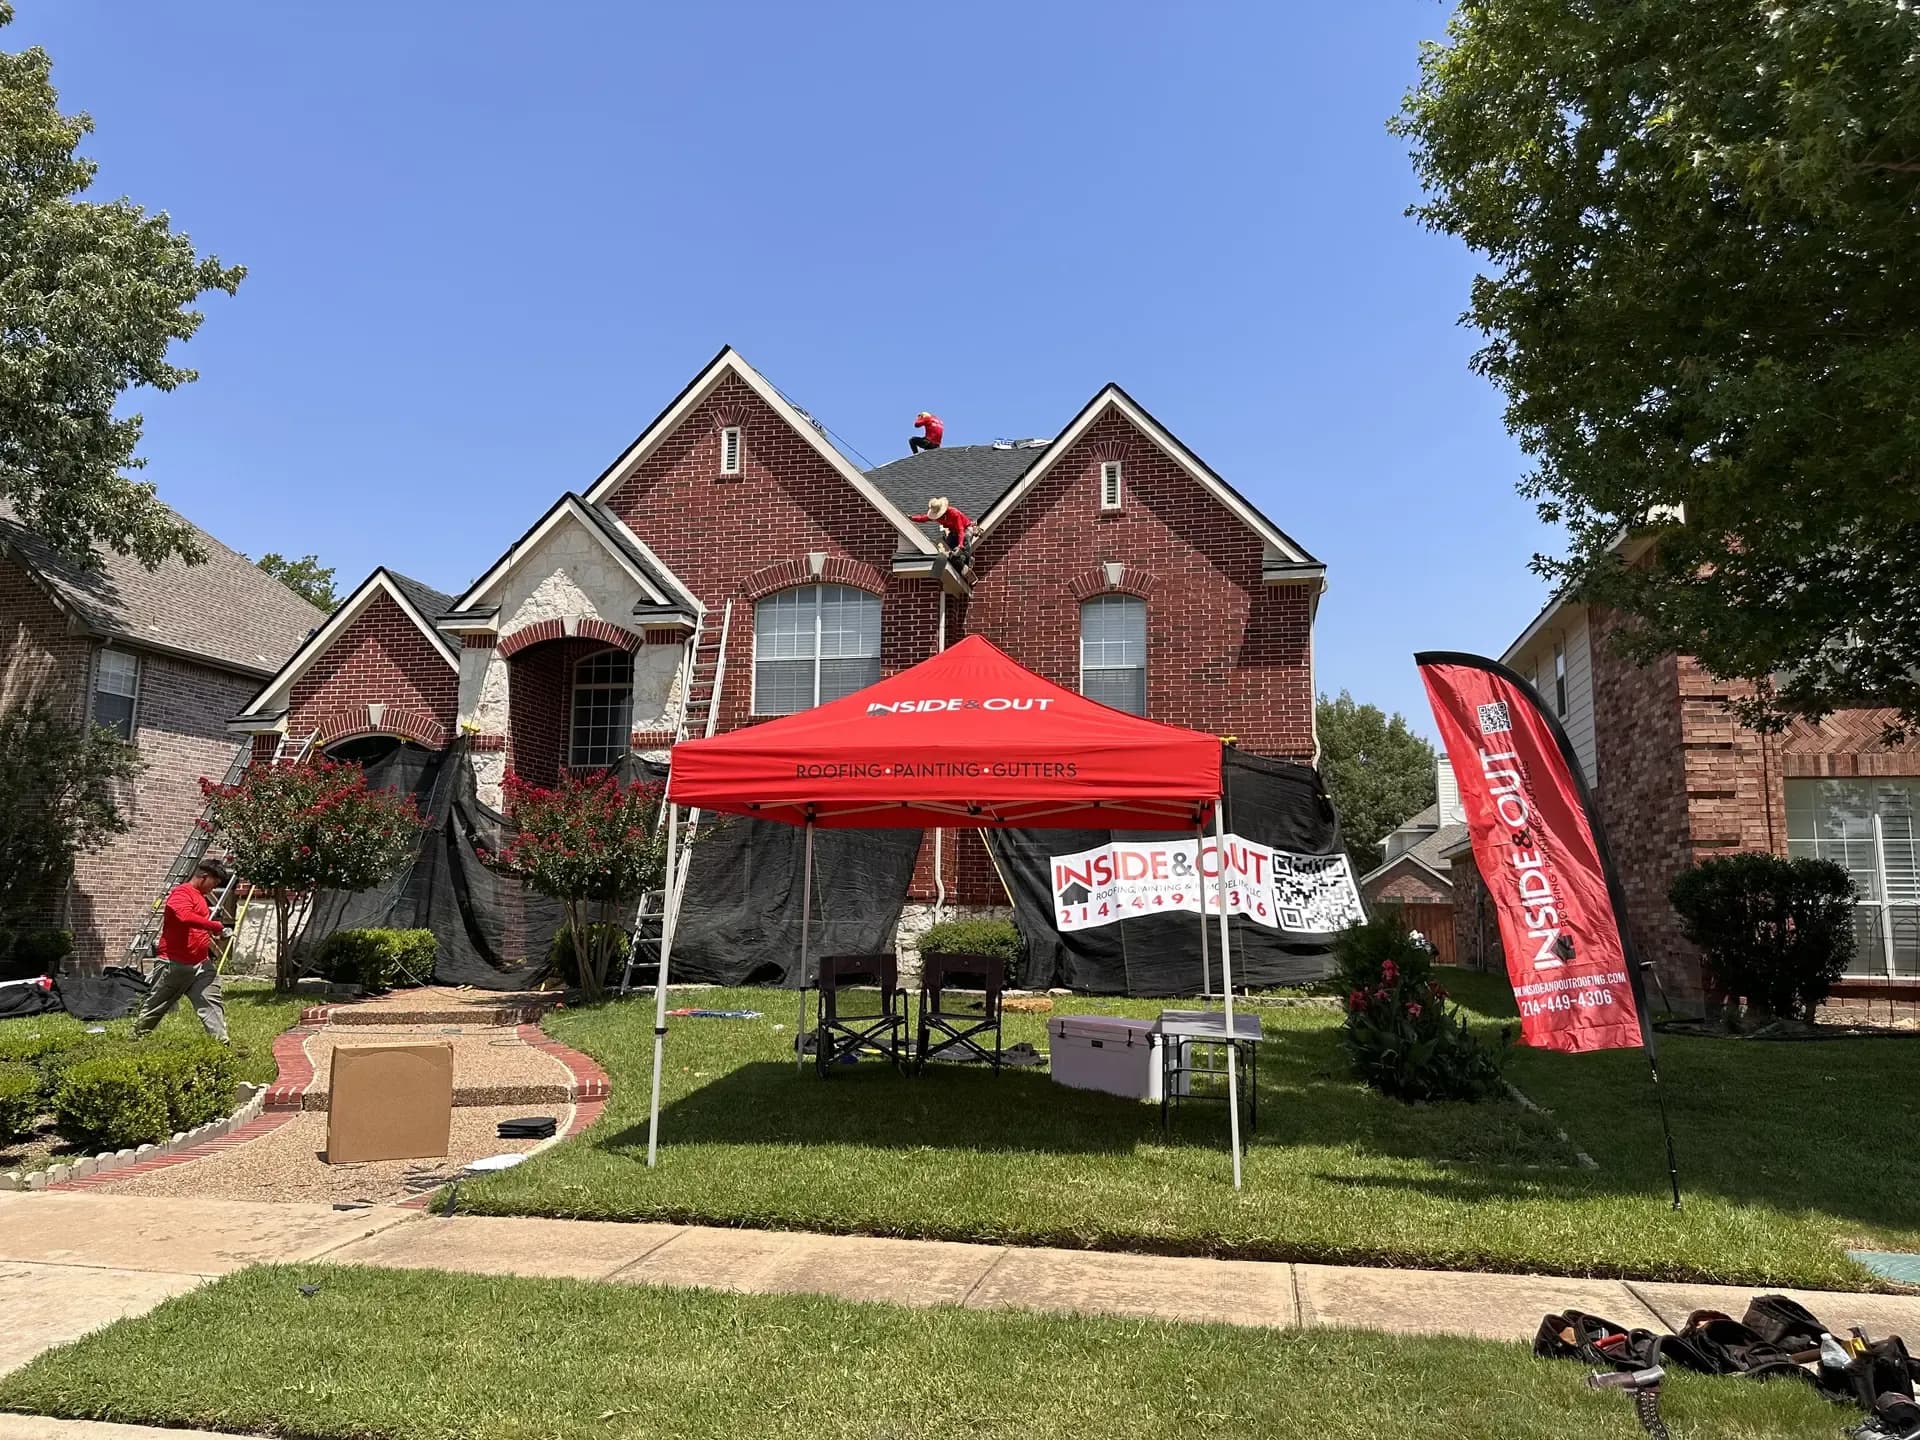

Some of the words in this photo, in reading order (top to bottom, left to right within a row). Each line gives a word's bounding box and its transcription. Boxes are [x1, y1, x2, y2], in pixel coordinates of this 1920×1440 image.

[1480, 748, 1529, 827] OUT
[1511, 827, 1533, 848] &
[1056, 851, 1169, 891] INSIDE
[1172, 852, 1195, 877] &
[1196, 843, 1268, 885] OUT
[1510, 850, 1564, 971] INSIDE
[1549, 874, 1568, 928] ROOFING
[1522, 989, 1613, 1016] 214-449-4306
